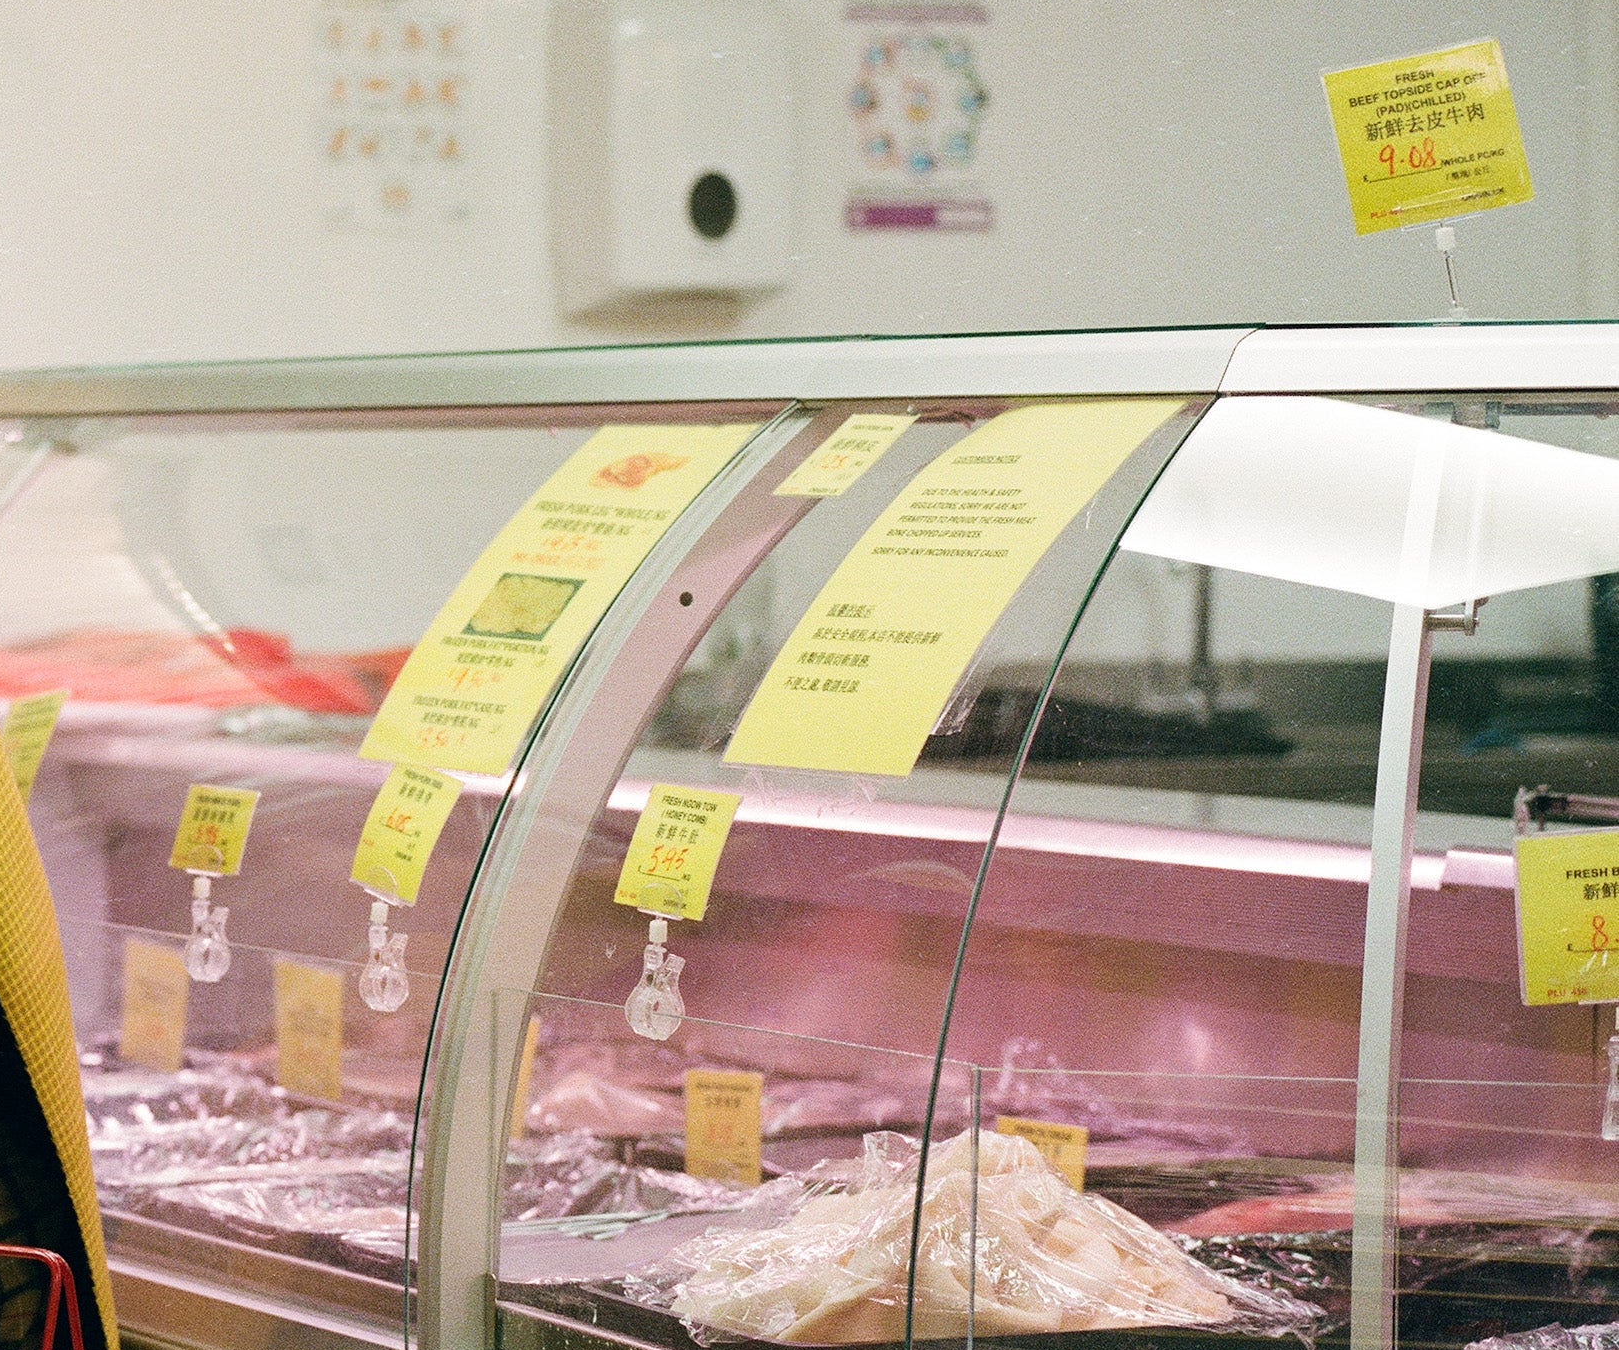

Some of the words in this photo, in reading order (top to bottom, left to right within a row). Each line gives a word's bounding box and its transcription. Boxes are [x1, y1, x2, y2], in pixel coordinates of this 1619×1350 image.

[1395, 69, 1434, 84] FRESH
[1349, 93, 1380, 108] BEEF
[1383, 82, 1433, 101] TOPSIDE
[1435, 78, 1460, 91] CAP
[1365, 102, 1484, 142] 新鮮去皮牛肉
[1379, 137, 1437, 175] 9.08
[996, 489, 1023, 497] SAFETY
[898, 515, 938, 524] PERMITTED
[938, 516, 948, 524] TO
[947, 516, 979, 524] PROVIDE
[980, 516, 993, 524] THE
[886, 528, 908, 537] BONE
[906, 529, 939, 538] CHOPPED
[871, 547, 895, 555] SORRY
[895, 547, 910, 556] FOR
[910, 548, 925, 556] ANY
[924, 548, 980, 557] INCONVENIENCE
[662, 795, 682, 806] FRESH
[682, 799, 703, 810] NGOW
[702, 802, 718, 812] TOW
[1566, 868, 1608, 880] FRESH
[1547, 988, 1566, 998] PLU
